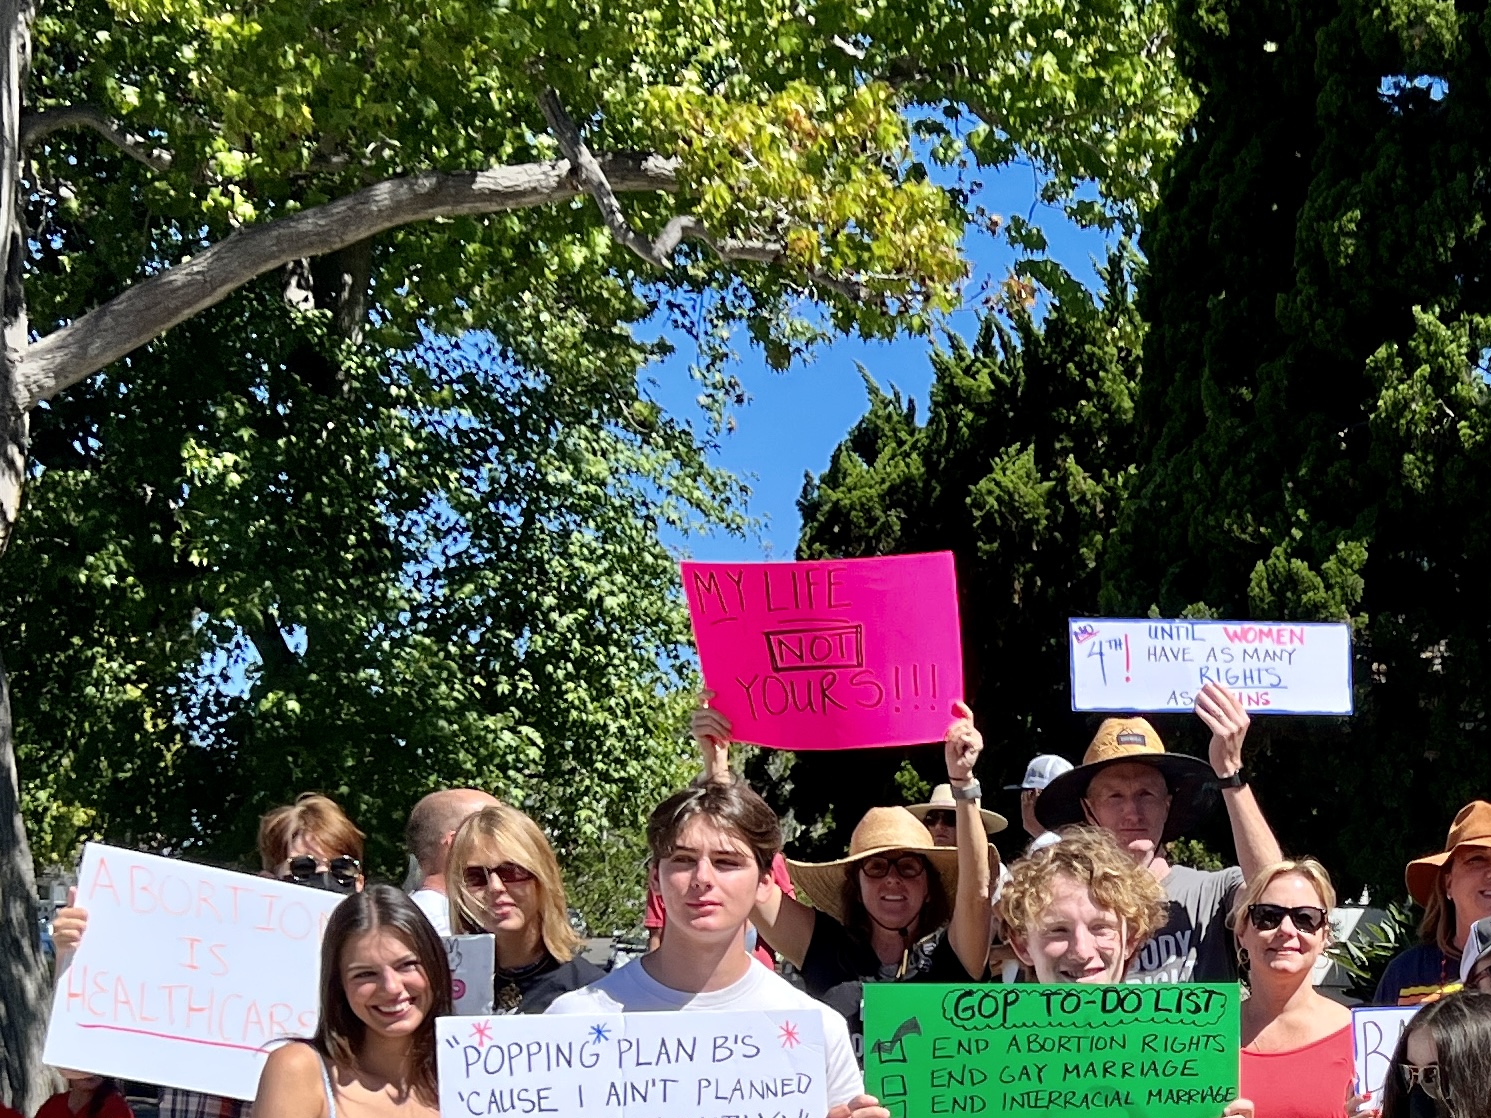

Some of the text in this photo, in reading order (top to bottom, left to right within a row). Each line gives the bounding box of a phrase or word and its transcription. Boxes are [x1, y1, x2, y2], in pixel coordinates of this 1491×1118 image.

[693, 567, 852, 615] MY LIFE
[777, 633, 846, 664] NOT
[1149, 624, 1305, 646] UNTIL WOMEN
[1147, 647, 1298, 665] HAVE AS MANY
[1200, 665, 1282, 687] RIGHTS
[1167, 690, 1193, 706] AS
[177, 936, 228, 977] IS
[954, 990, 1216, 1025] GOP TO-DO LIST
[617, 1037, 697, 1068] PLAN
[712, 1034, 761, 1063] B'S
[932, 1032, 1226, 1060] END ABORTION RIGHTS
[930, 1059, 1199, 1089] END GAY MARRIAGE
[457, 1072, 812, 1116] 'CAUSE I AIN'T PLANNED
[931, 1085, 1236, 1114] END INTERRACIAL MARRIAGE
